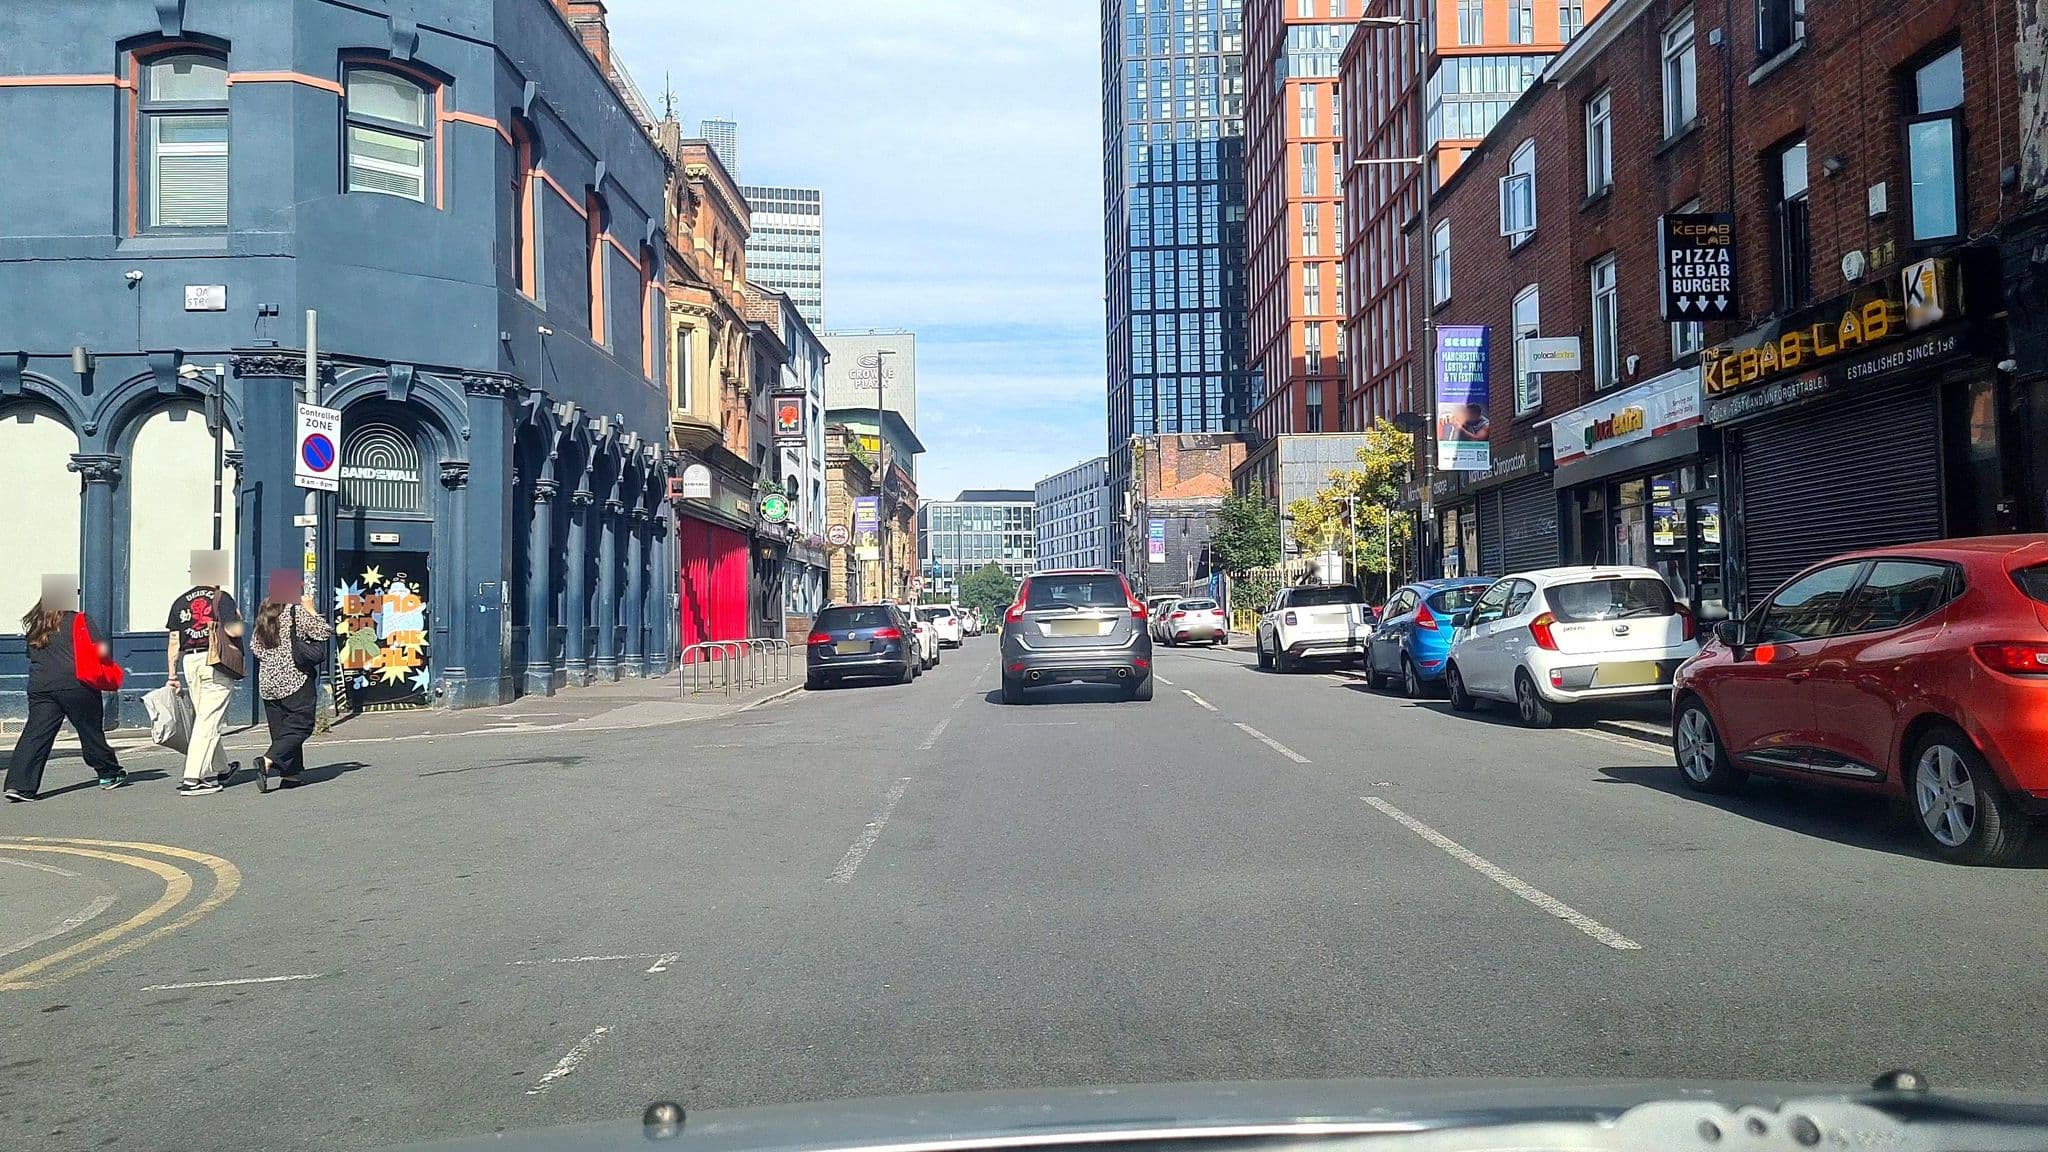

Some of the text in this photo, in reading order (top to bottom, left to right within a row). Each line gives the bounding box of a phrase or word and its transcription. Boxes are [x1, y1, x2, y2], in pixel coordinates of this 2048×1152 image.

[1673, 225, 1730, 235] KEBAB
[1696, 235, 1730, 246] LAB
[1671, 248, 1730, 263] PIZZA
[1672, 264, 1730, 278] KEBAB
[1672, 278, 1730, 293] BURGER
[1700, 299, 1889, 394] The KEBAB LAB
[1847, 352, 1904, 380] ESTABLISHED
[1907, 342, 1934, 362] SINCE
[1459, 372, 1484, 382] FESTIVAL
[299, 407, 340, 422] Controlled
[305, 418, 333, 431] ZONE
[341, 467, 376, 479] BAND
[386, 469, 419, 482] WALL
